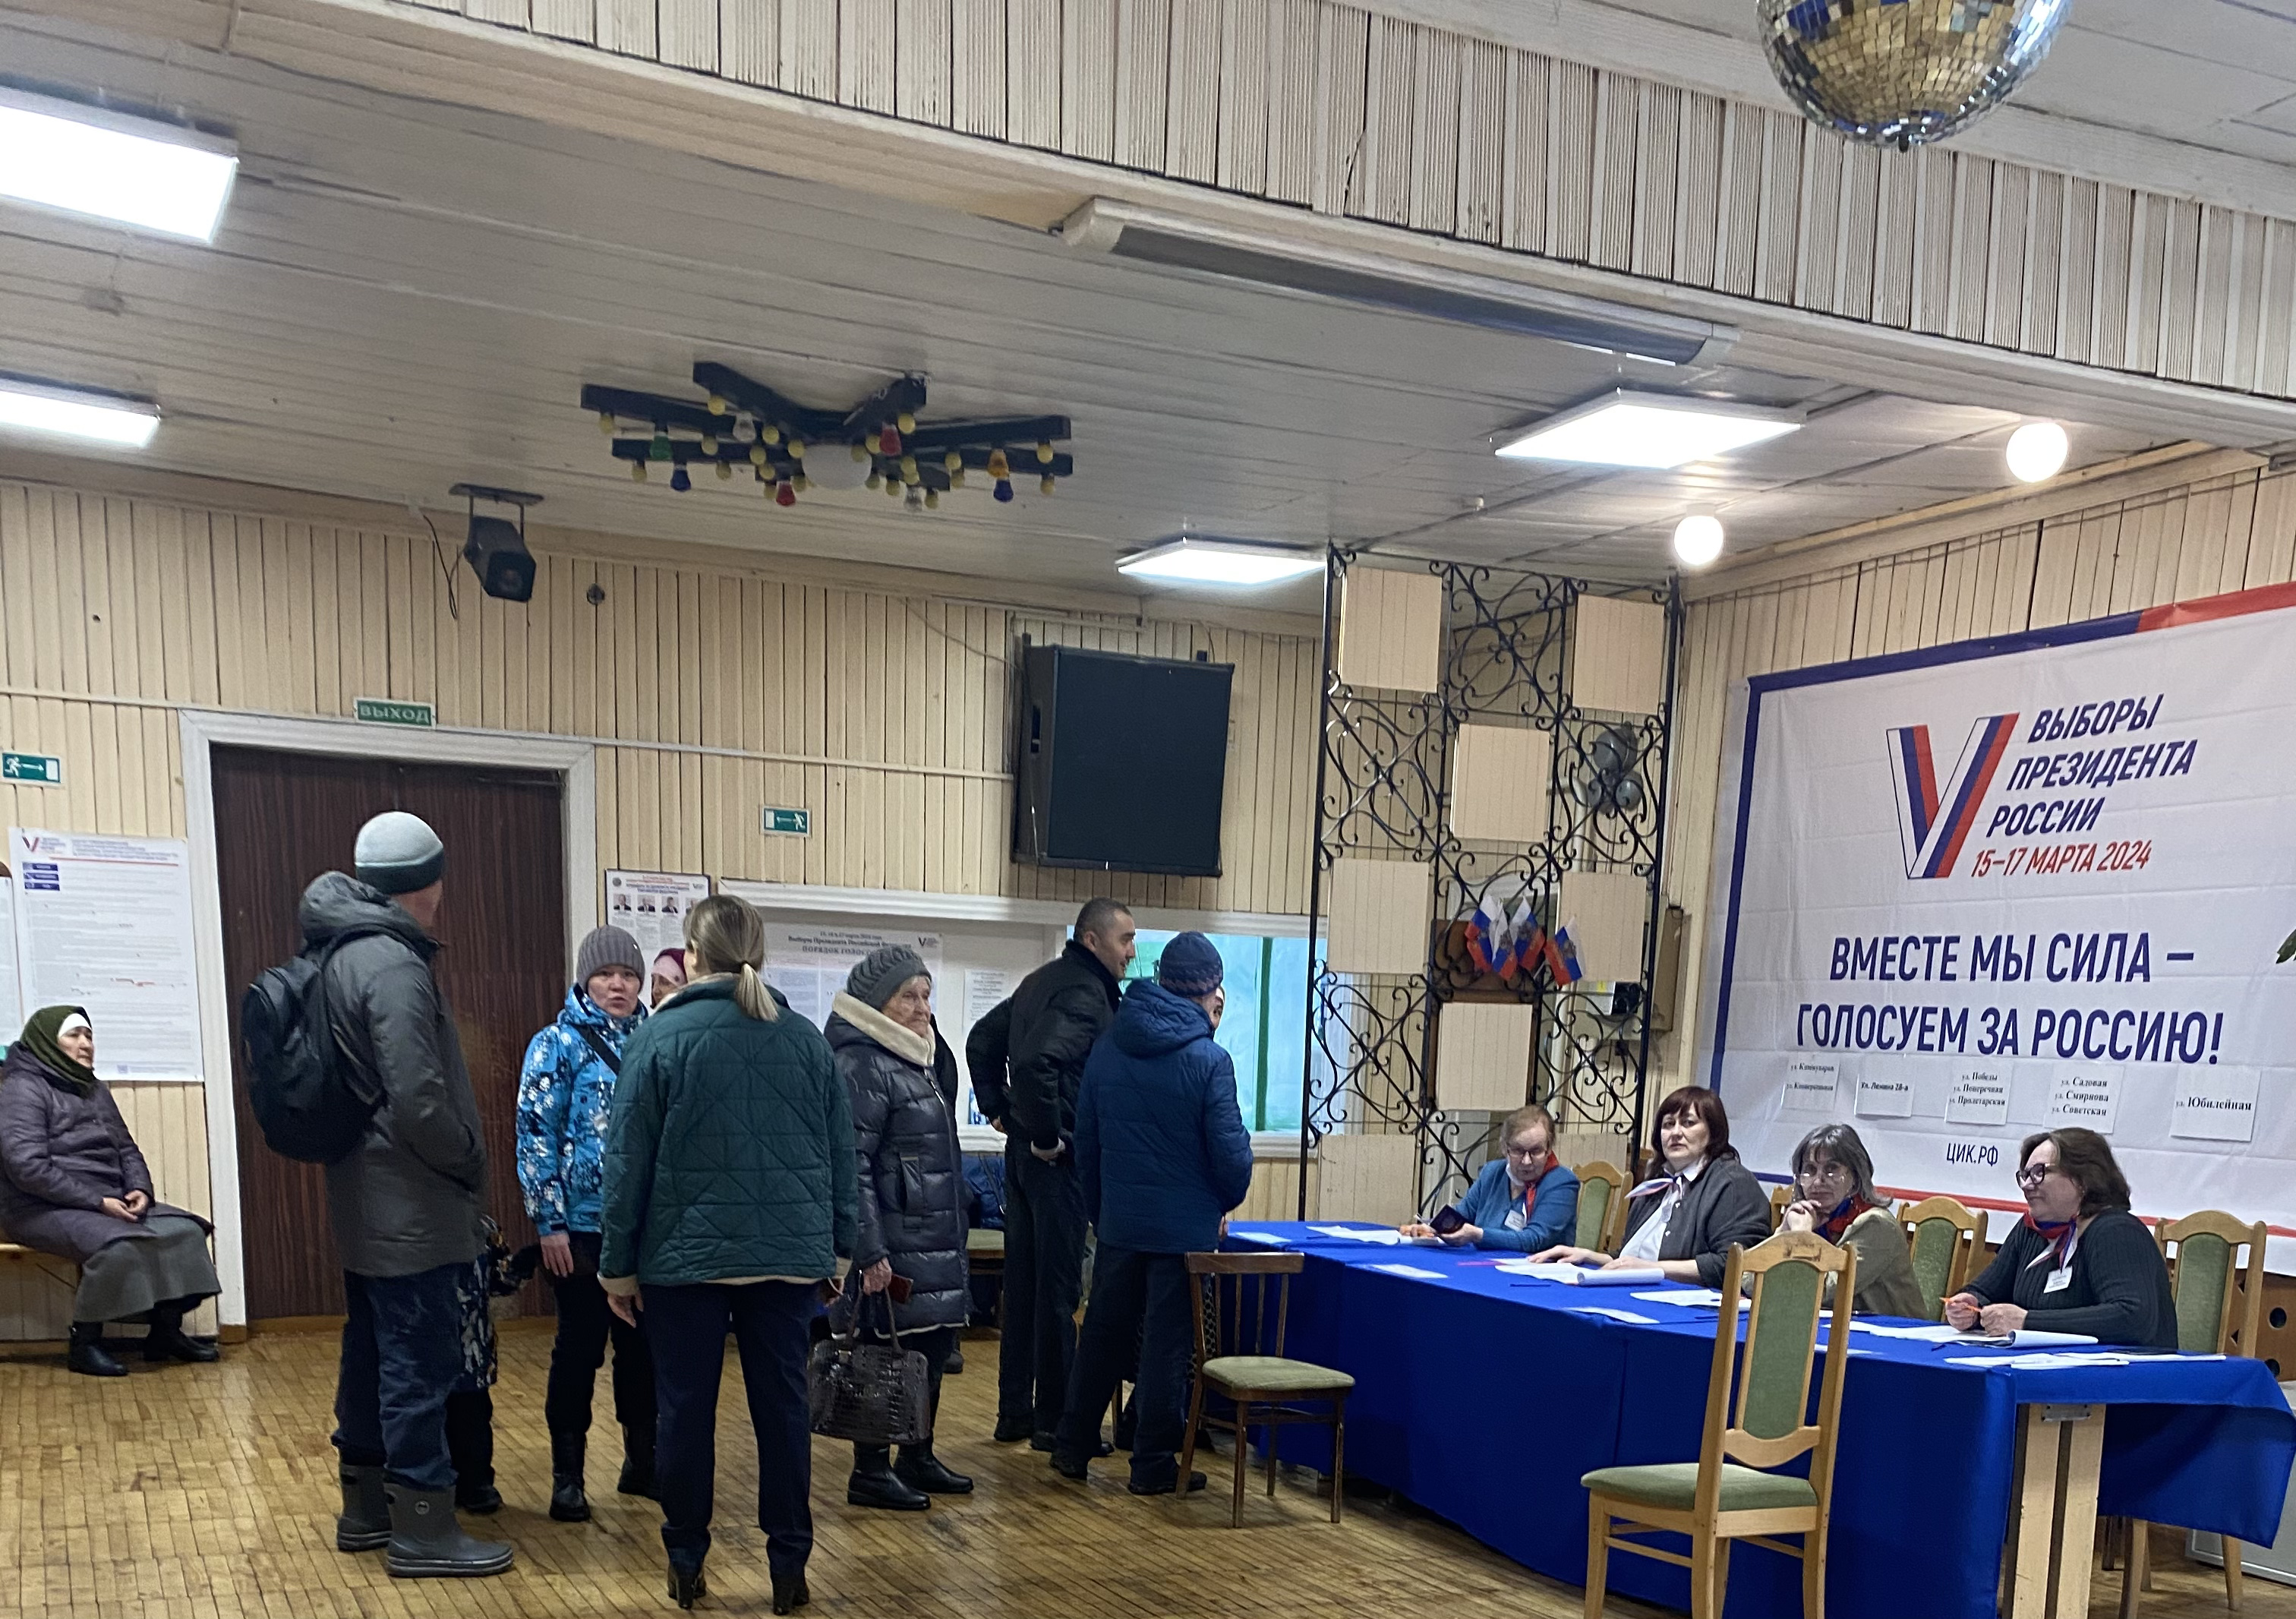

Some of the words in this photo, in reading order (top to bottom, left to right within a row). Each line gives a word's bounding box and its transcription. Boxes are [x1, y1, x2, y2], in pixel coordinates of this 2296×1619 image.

[360, 705, 430, 724] ВЫХОД
[2027, 693, 2164, 743] ВЫБОРЫ
[2006, 739, 2198, 791] ПРЕЗИДЕНТА
[1986, 797, 2105, 838] РОССИИ
[2025, 843, 2098, 875] МАРТА
[2096, 839, 2152, 871] 2024
[1830, 935, 1960, 981] ВМЕСТЕ
[1970, 934, 2036, 982] МЫ
[2046, 933, 2150, 982] СИЛА
[1797, 1003, 1969, 1053] ГОЛОСУЕМ
[1977, 1007, 2018, 1056] ЗА
[2031, 1008, 2223, 1065] РОССИЮ!
[1973, 1071, 1998, 1081] Победы
[2073, 1077, 2108, 1087] Садовая
[1958, 1095, 2005, 1107] Пролетарская
[2066, 1090, 2108, 1103] Смирнова
[2187, 1096, 2251, 1110] Юбилейная
[2063, 1104, 2107, 1116] Советская
[1947, 1143, 1998, 1167] ЦИК.РФ
